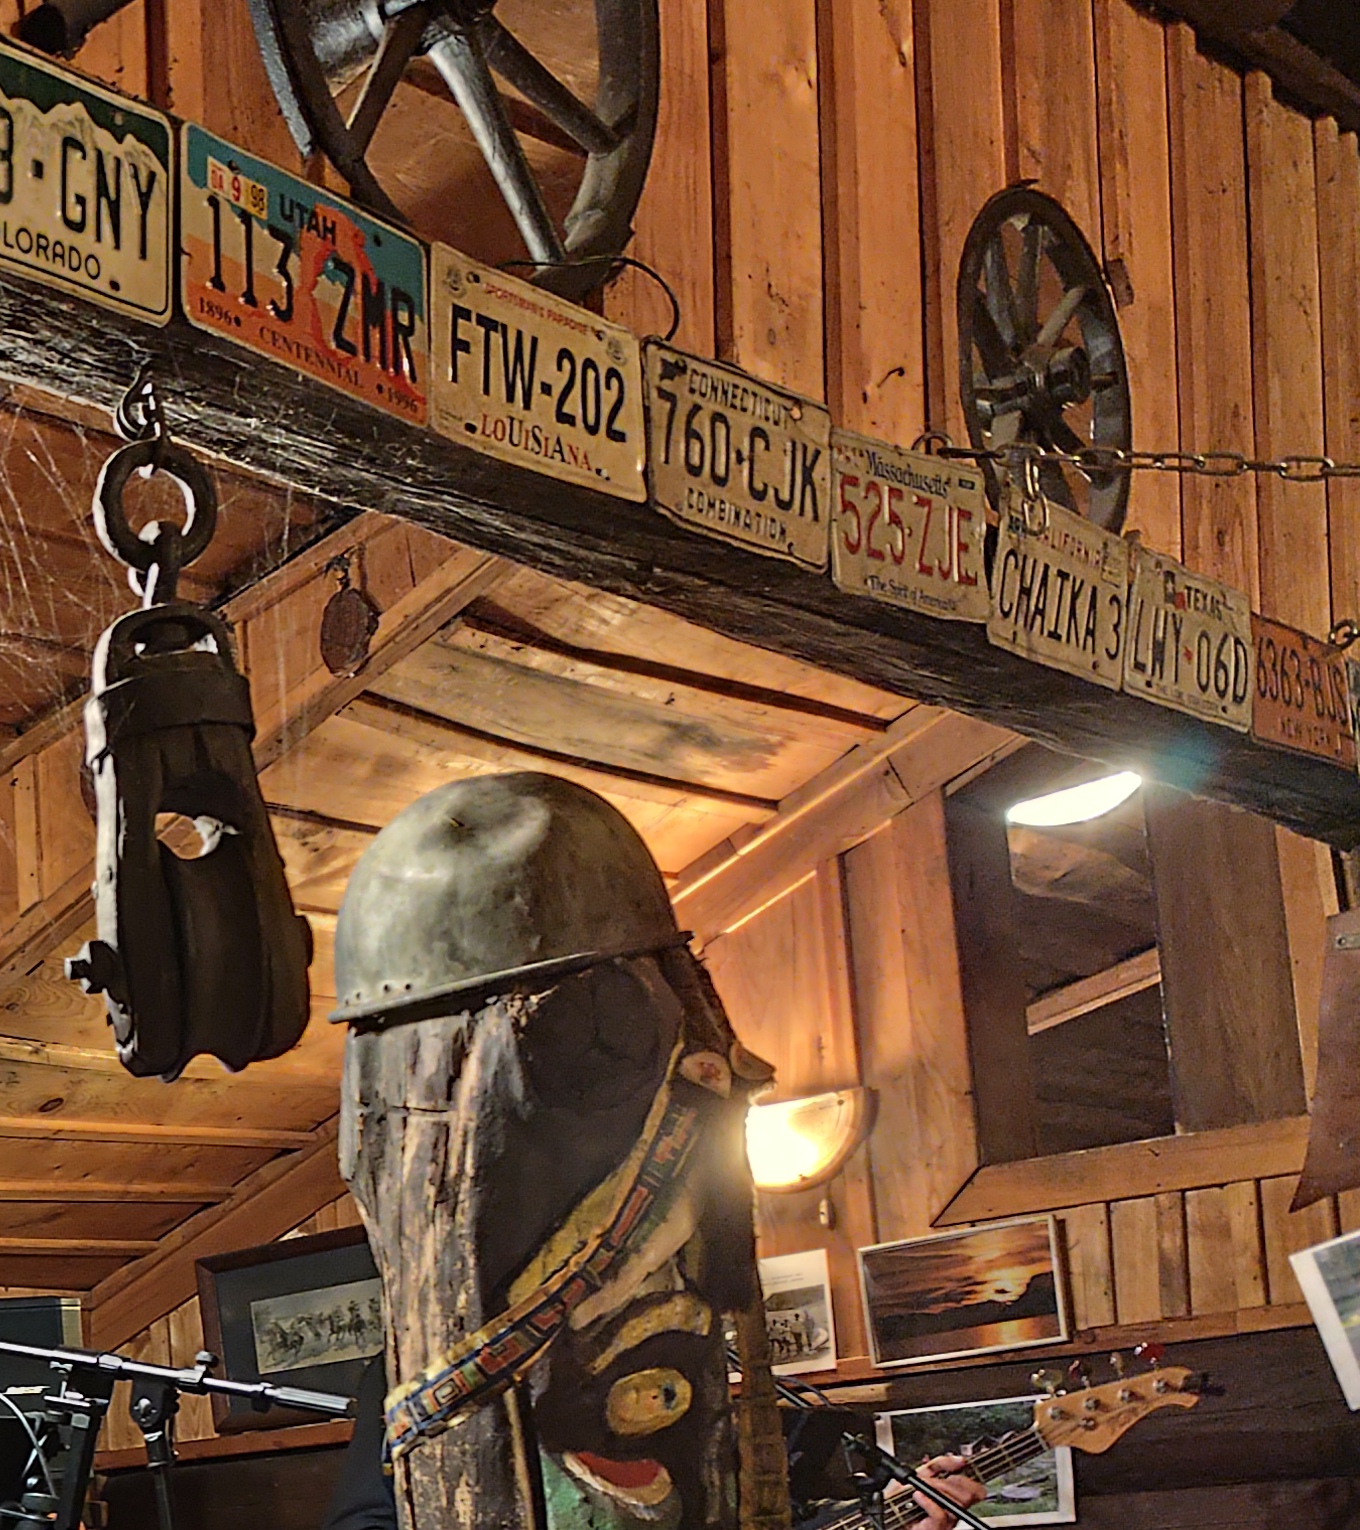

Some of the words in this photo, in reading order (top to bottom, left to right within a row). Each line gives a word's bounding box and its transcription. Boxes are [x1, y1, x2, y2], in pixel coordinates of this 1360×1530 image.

[280, 193, 336, 246] UTAH
[206, 195, 294, 322] 113
[328, 256, 417, 384] ZMR
[199, 297, 232, 325] 1896
[259, 326, 364, 388] CENTENNIAL
[388, 387, 418, 413] 1996
[451, 303, 626, 442] FTW-202
[688, 368, 791, 430] CONNECTICUT
[482, 414, 592, 471] LOUISIANA
[866, 450, 951, 498] Massachusetts
[687, 486, 787, 542] COMBINATION
[999, 548, 1098, 655] CHAIKA
[1105, 594, 1122, 660] 3
[1185, 585, 1222, 621] TEXAS
[1196, 630, 1248, 705] 06D
